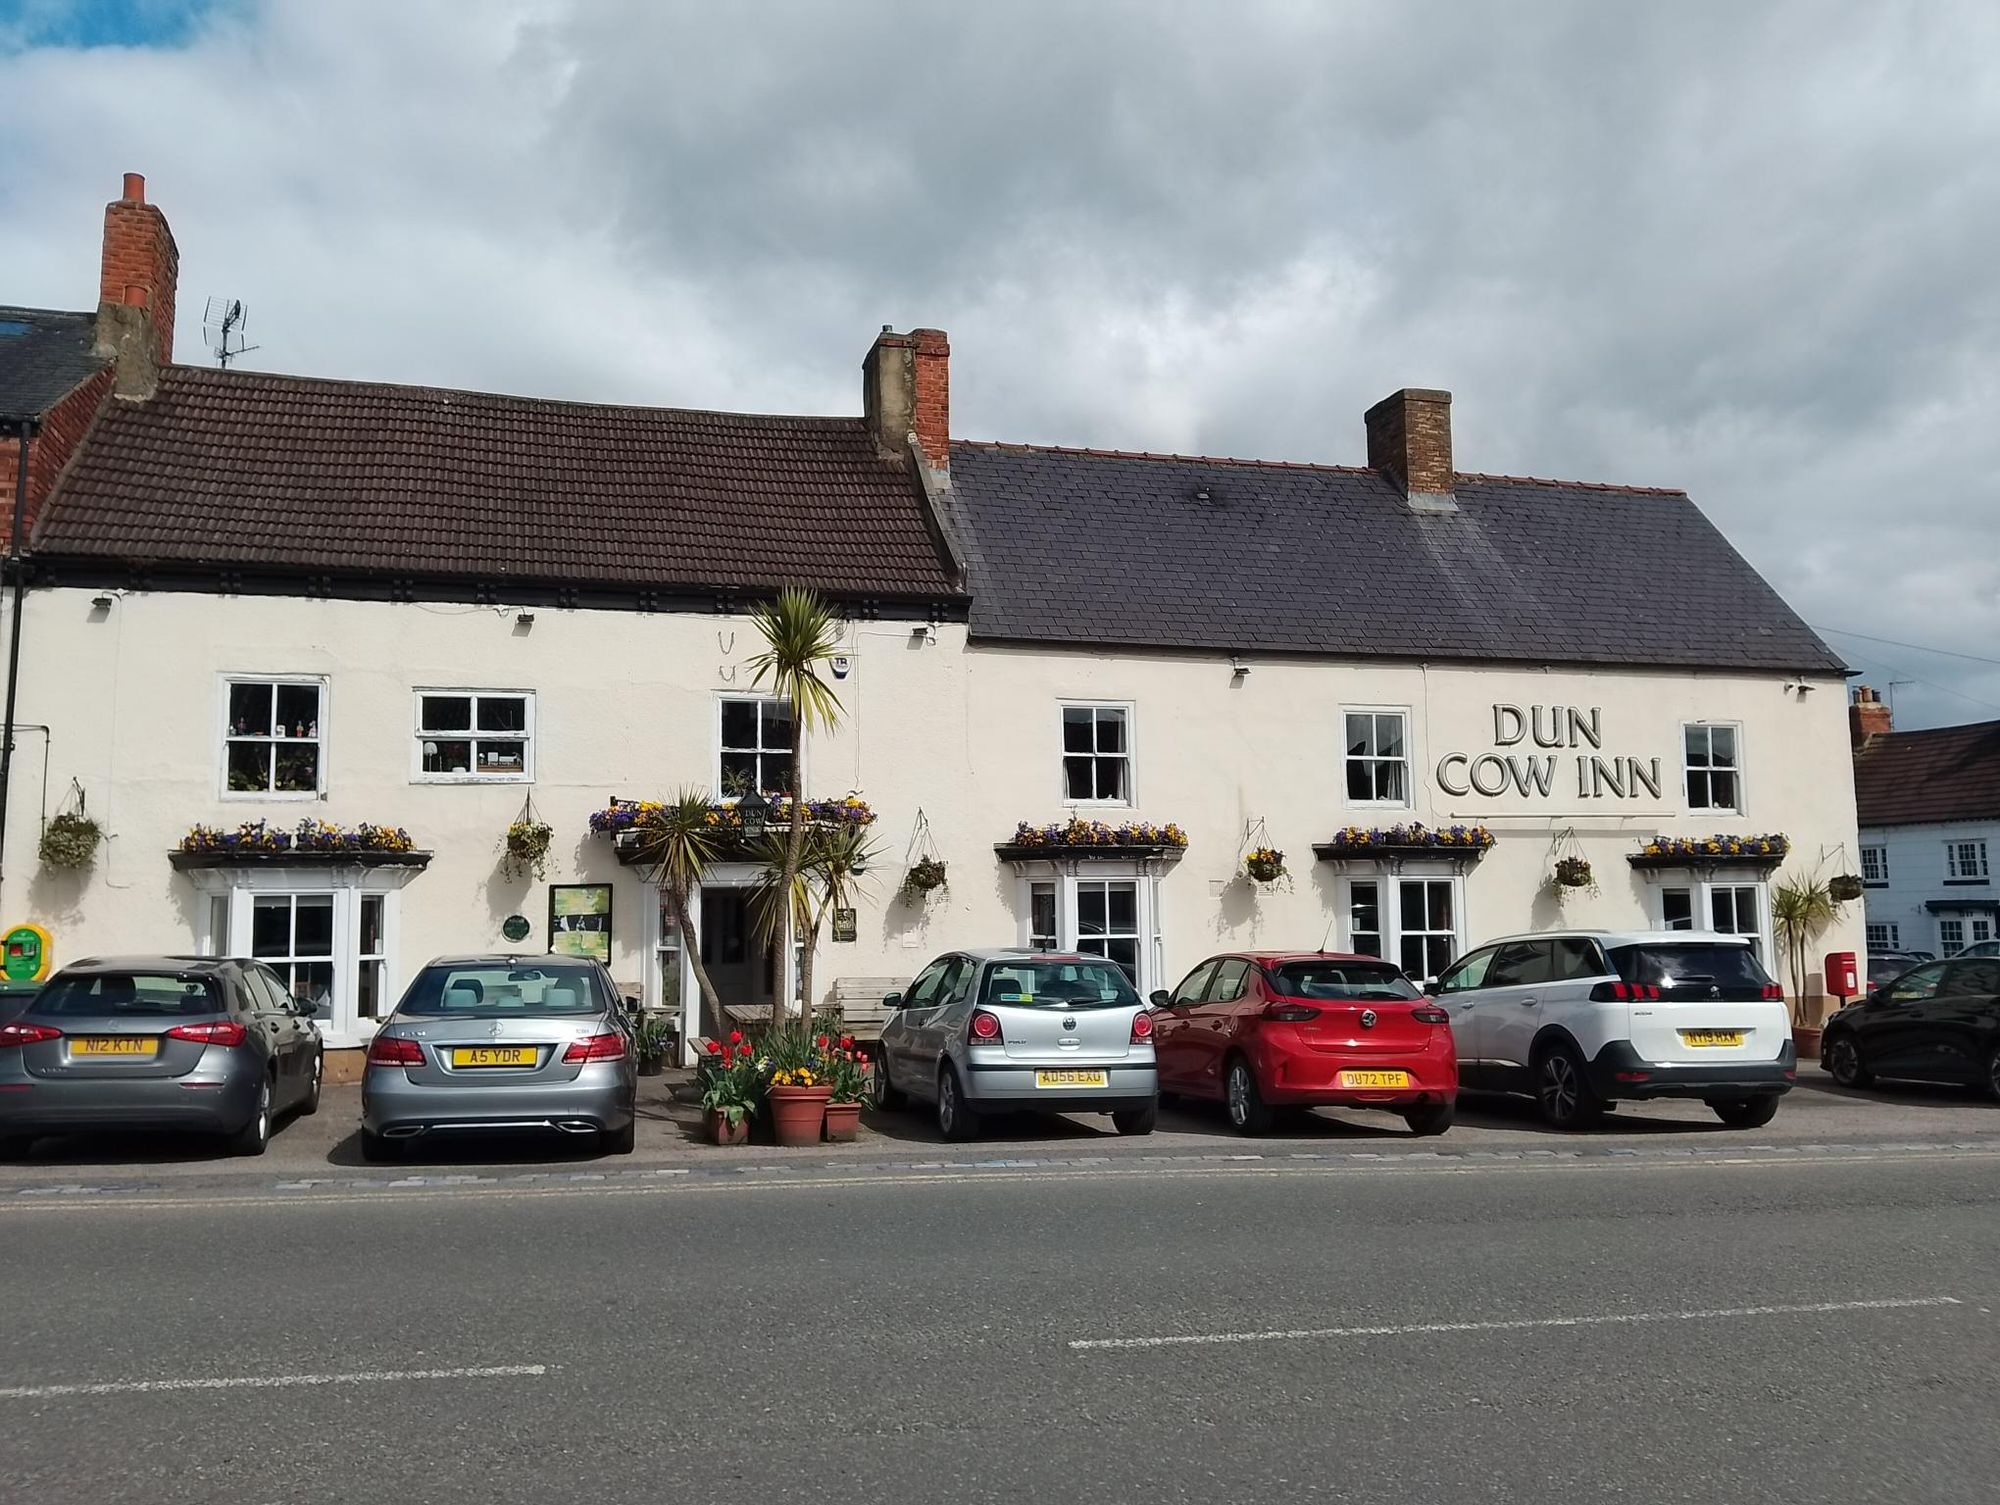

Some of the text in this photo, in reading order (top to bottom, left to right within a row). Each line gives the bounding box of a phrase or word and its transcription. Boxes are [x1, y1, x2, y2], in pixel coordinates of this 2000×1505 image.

[1492, 703, 1601, 749] DUN
[1436, 752, 1661, 799] COW INN
[86, 1038, 143, 1052] N12 KTN
[470, 1050, 521, 1062] A5 YDR
[1381, 1073, 1402, 1085] TPF
